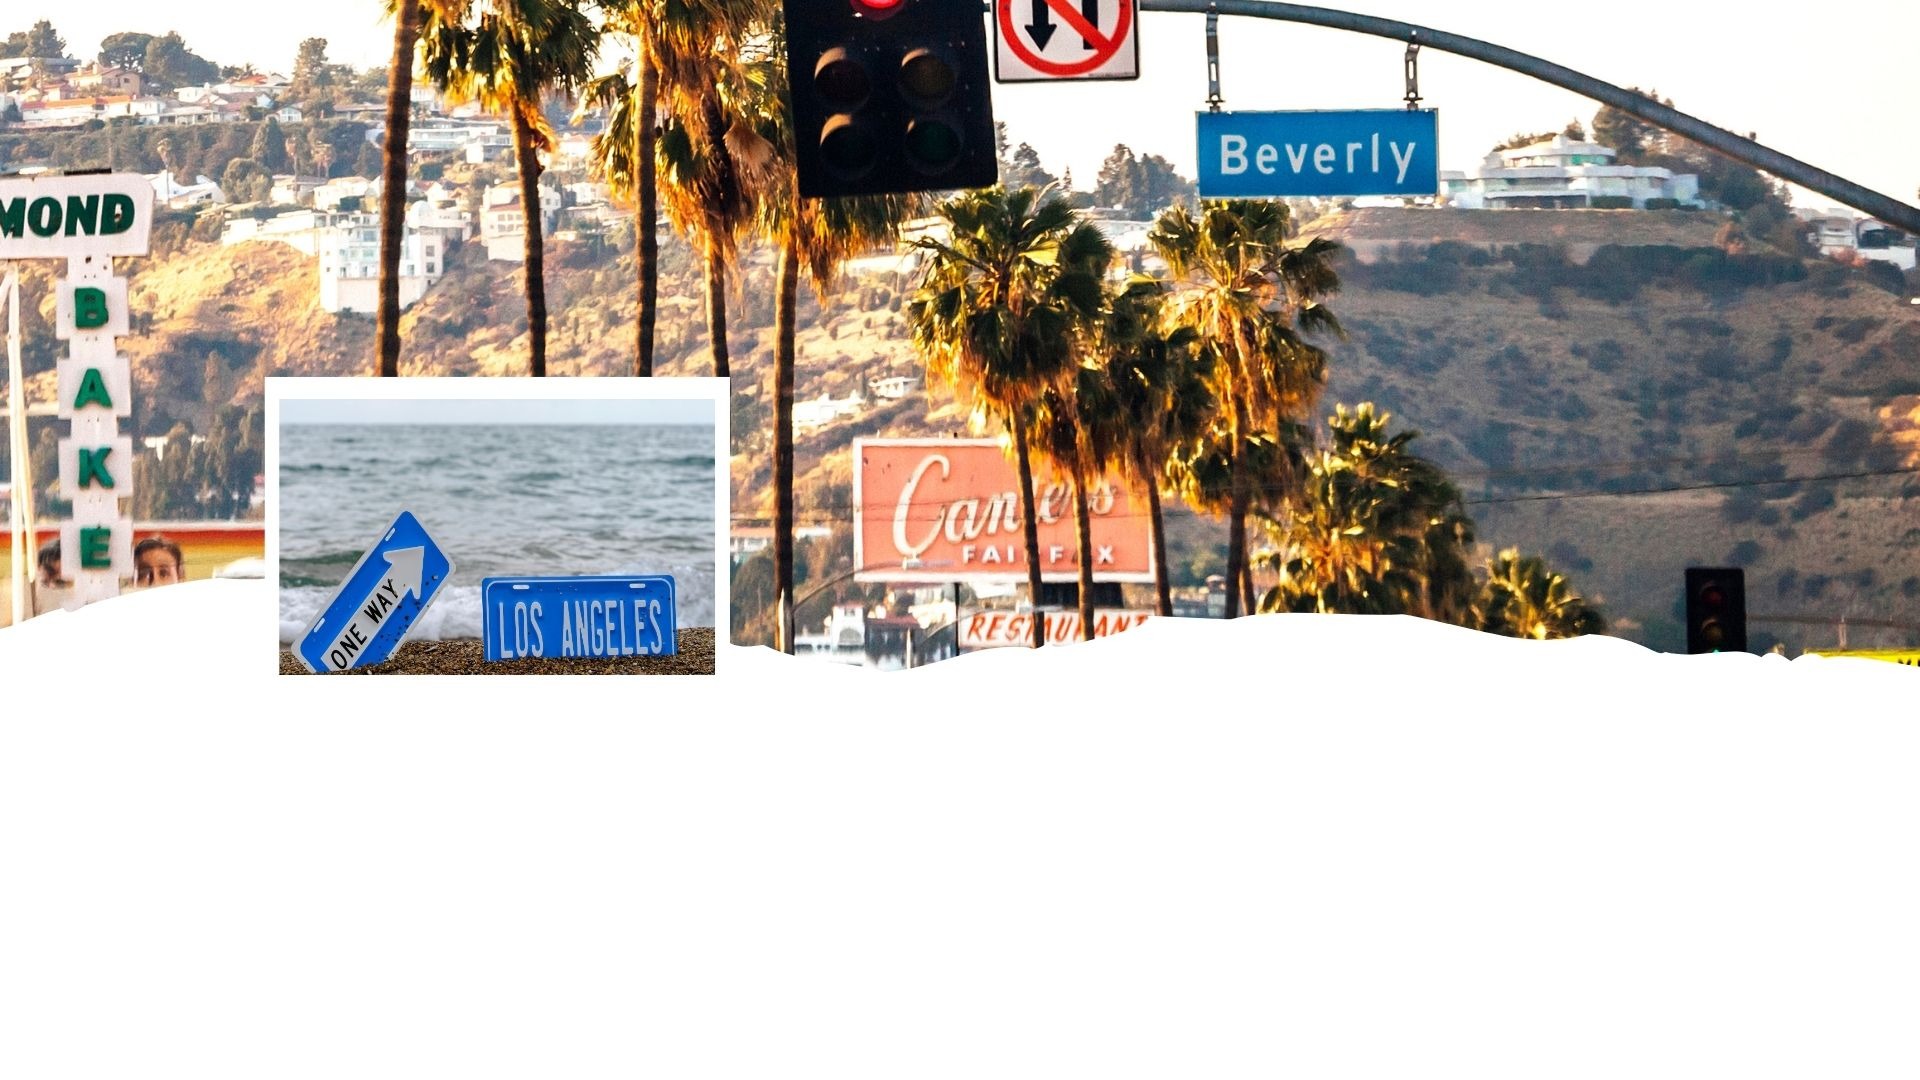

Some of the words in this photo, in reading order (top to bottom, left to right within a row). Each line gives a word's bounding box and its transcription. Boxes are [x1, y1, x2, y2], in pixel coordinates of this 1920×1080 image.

[1220, 132, 1416, 185] Beverly
[962, 545, 1114, 564] FAIFX
[330, 622, 368, 670] ONE
[363, 578, 399, 624] WAY
[499, 601, 544, 658] LOS
[562, 599, 663, 656] ANGELES
